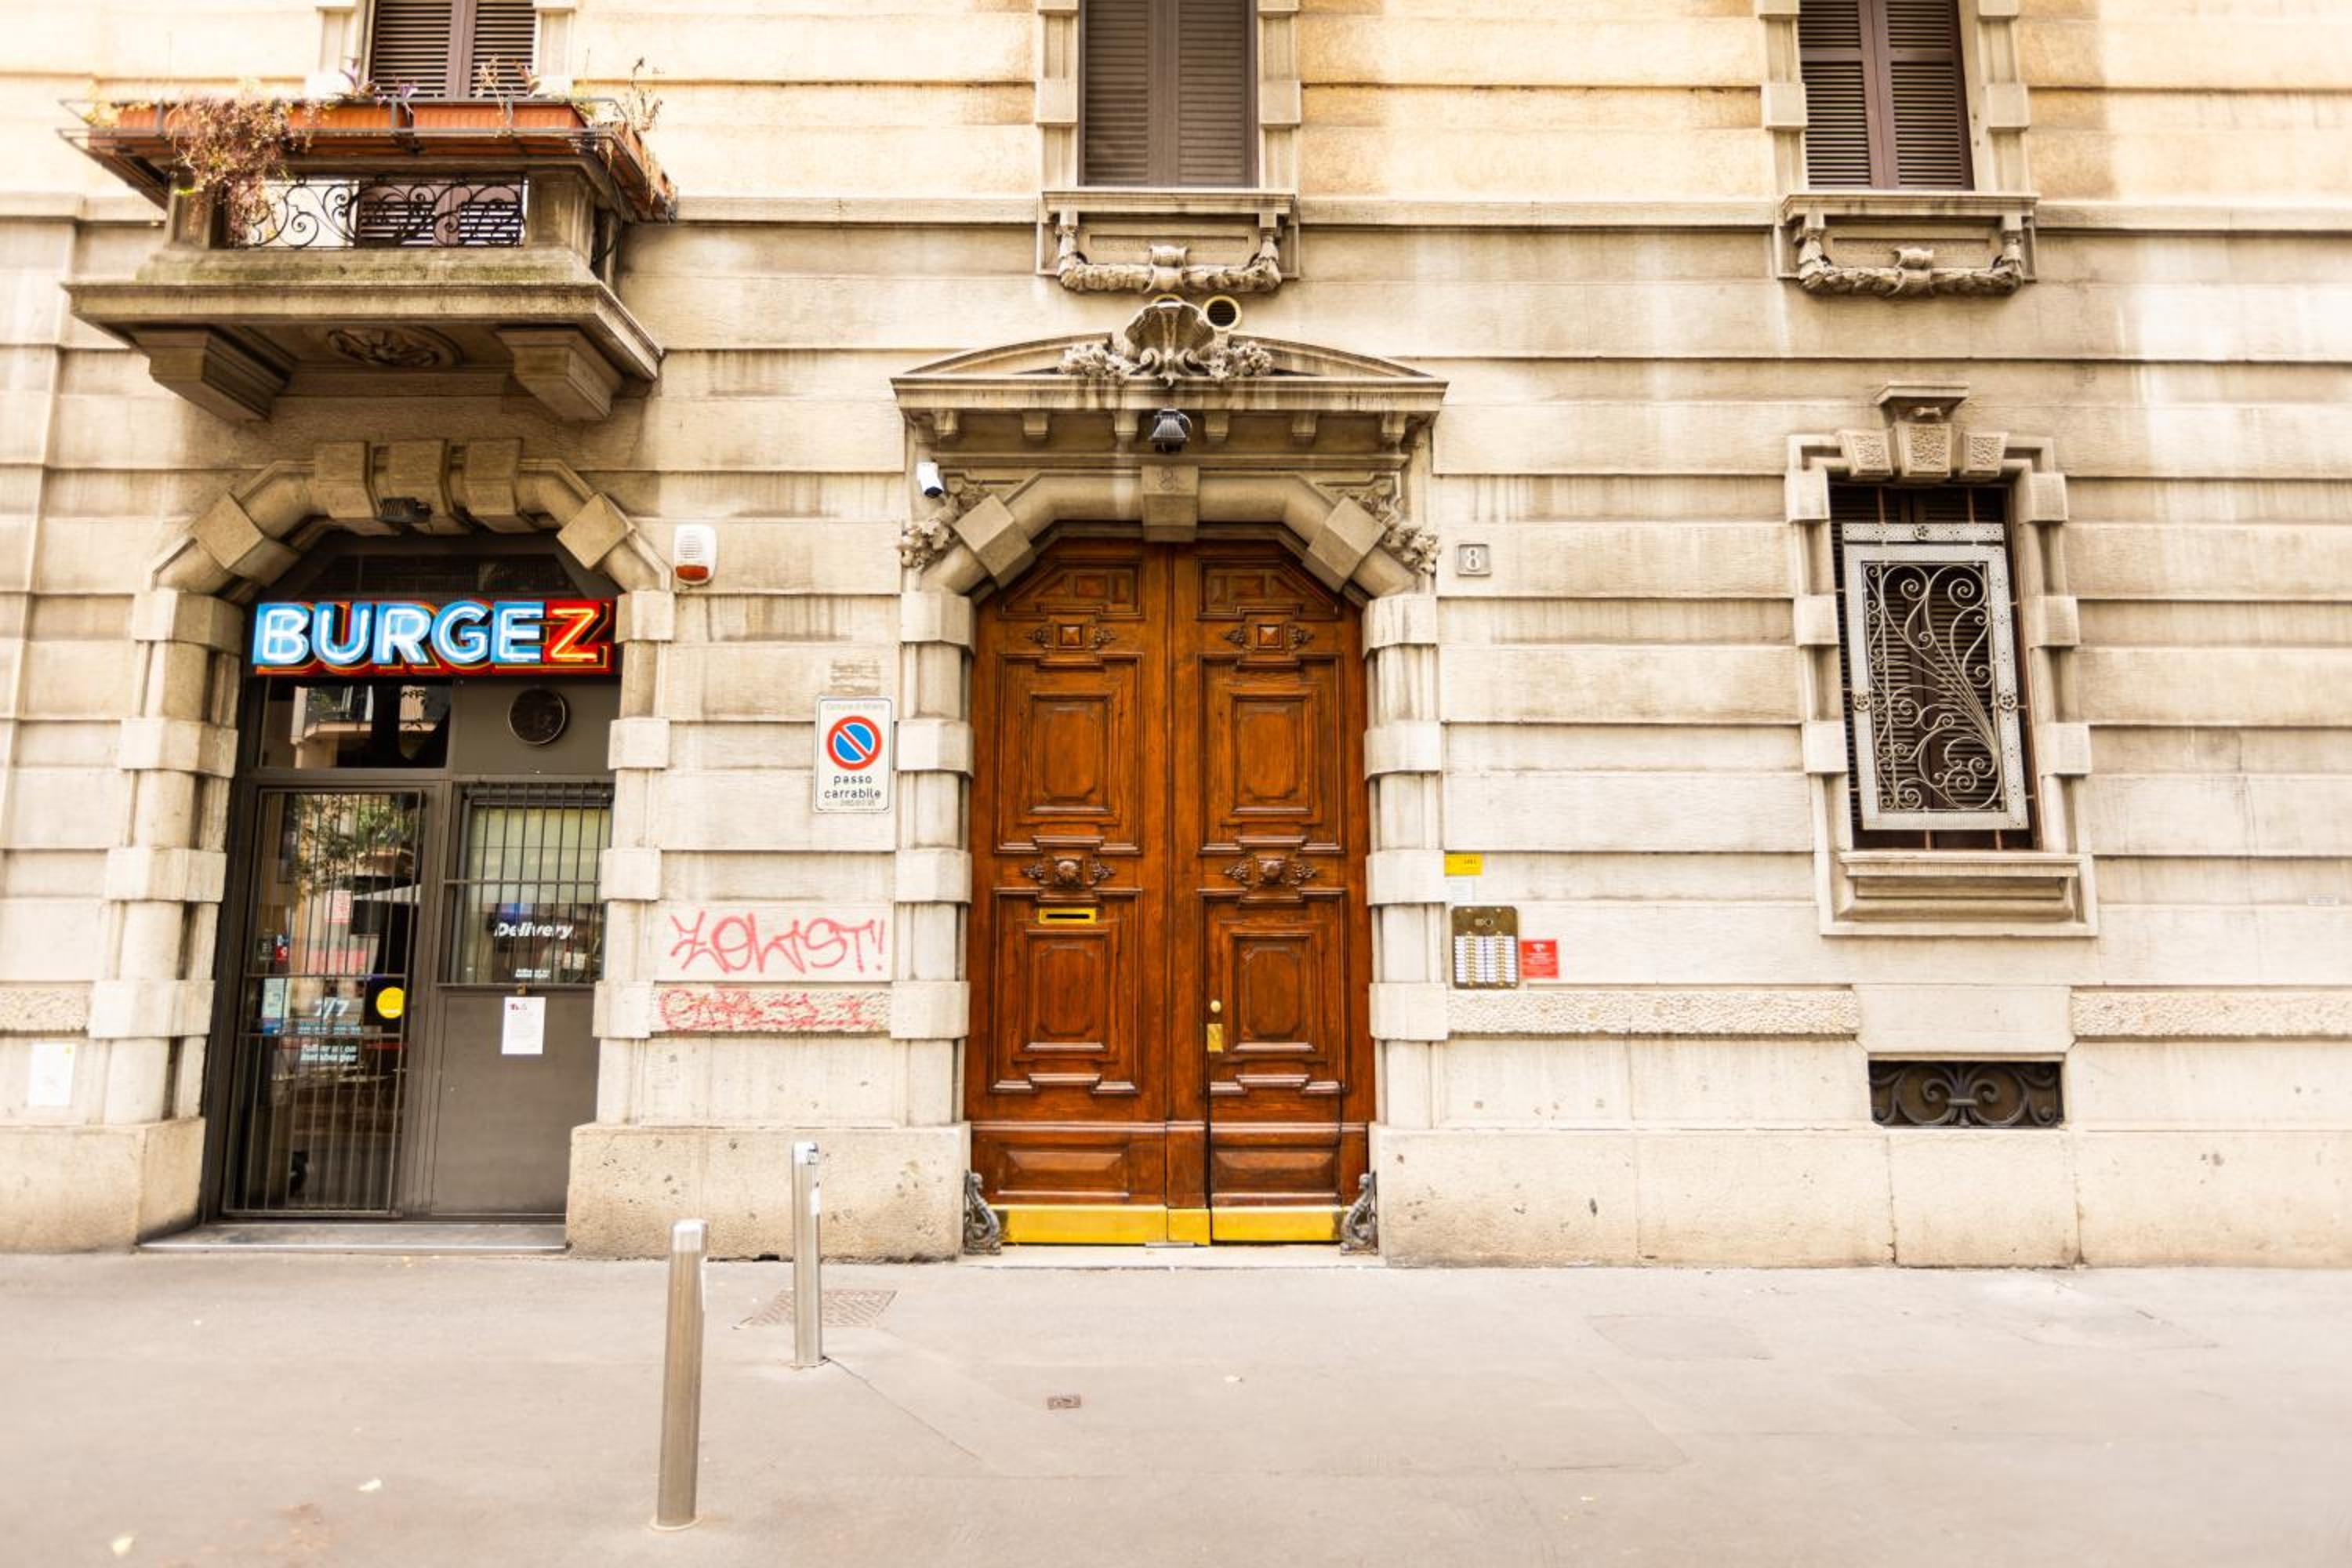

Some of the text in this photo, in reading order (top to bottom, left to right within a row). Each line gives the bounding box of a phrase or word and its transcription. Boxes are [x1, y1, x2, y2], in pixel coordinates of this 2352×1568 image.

[1466, 546, 1480, 570] 8
[252, 601, 608, 672] BURGEZ
[833, 775, 873, 786] passo
[824, 788, 881, 799] carrabile
[494, 922, 574, 940] Delivery
